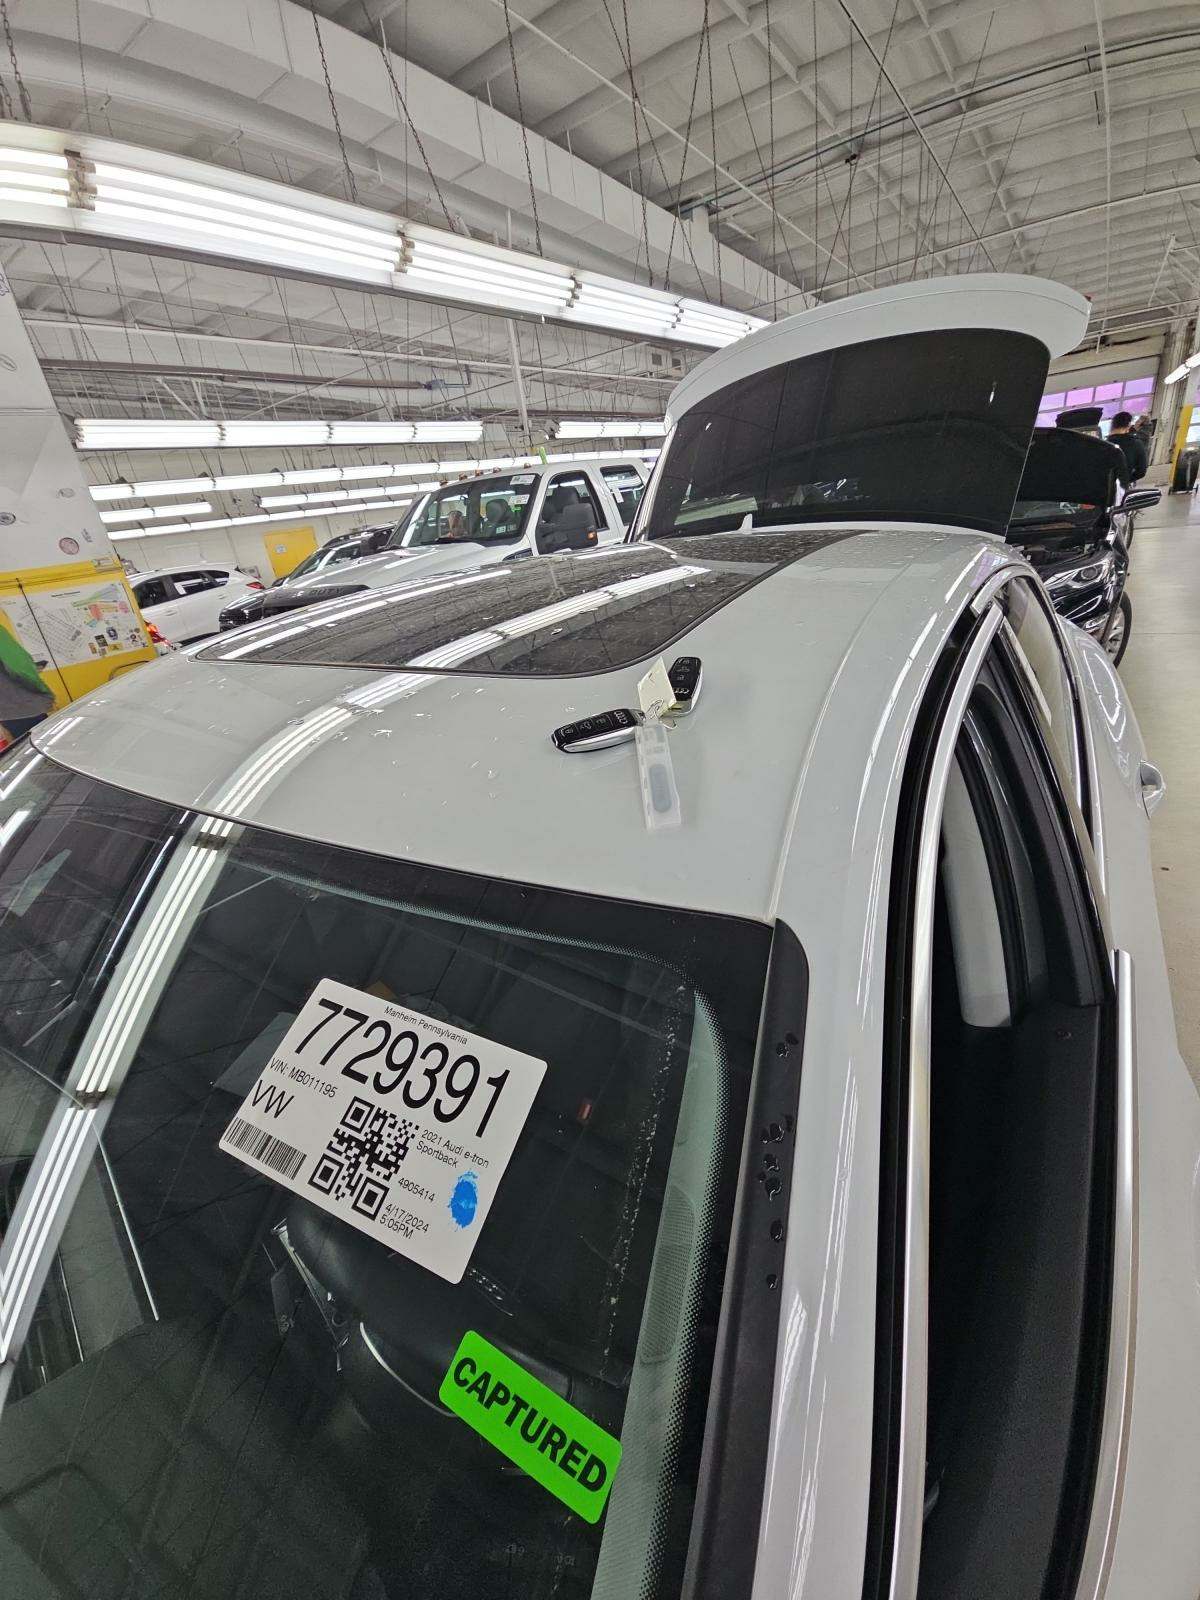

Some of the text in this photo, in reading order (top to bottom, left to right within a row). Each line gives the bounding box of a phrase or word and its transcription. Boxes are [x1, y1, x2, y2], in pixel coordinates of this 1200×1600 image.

[384, 1006, 468, 1045] Manheim Pennsylvania
[270, 1057, 338, 1098] VIN: MB011195
[294, 998, 511, 1138] 7729391
[251, 1079, 295, 1118] VW
[416, 1140, 459, 1168] Sportback
[421, 1129, 489, 1168] 2021 Audi e-tron
[398, 1177, 435, 1202] 4905414
[379, 1214, 414, 1239] 5:05PM
[386, 1203, 430, 1233] 4/17/2024
[453, 1357, 607, 1492] CAPTURED
